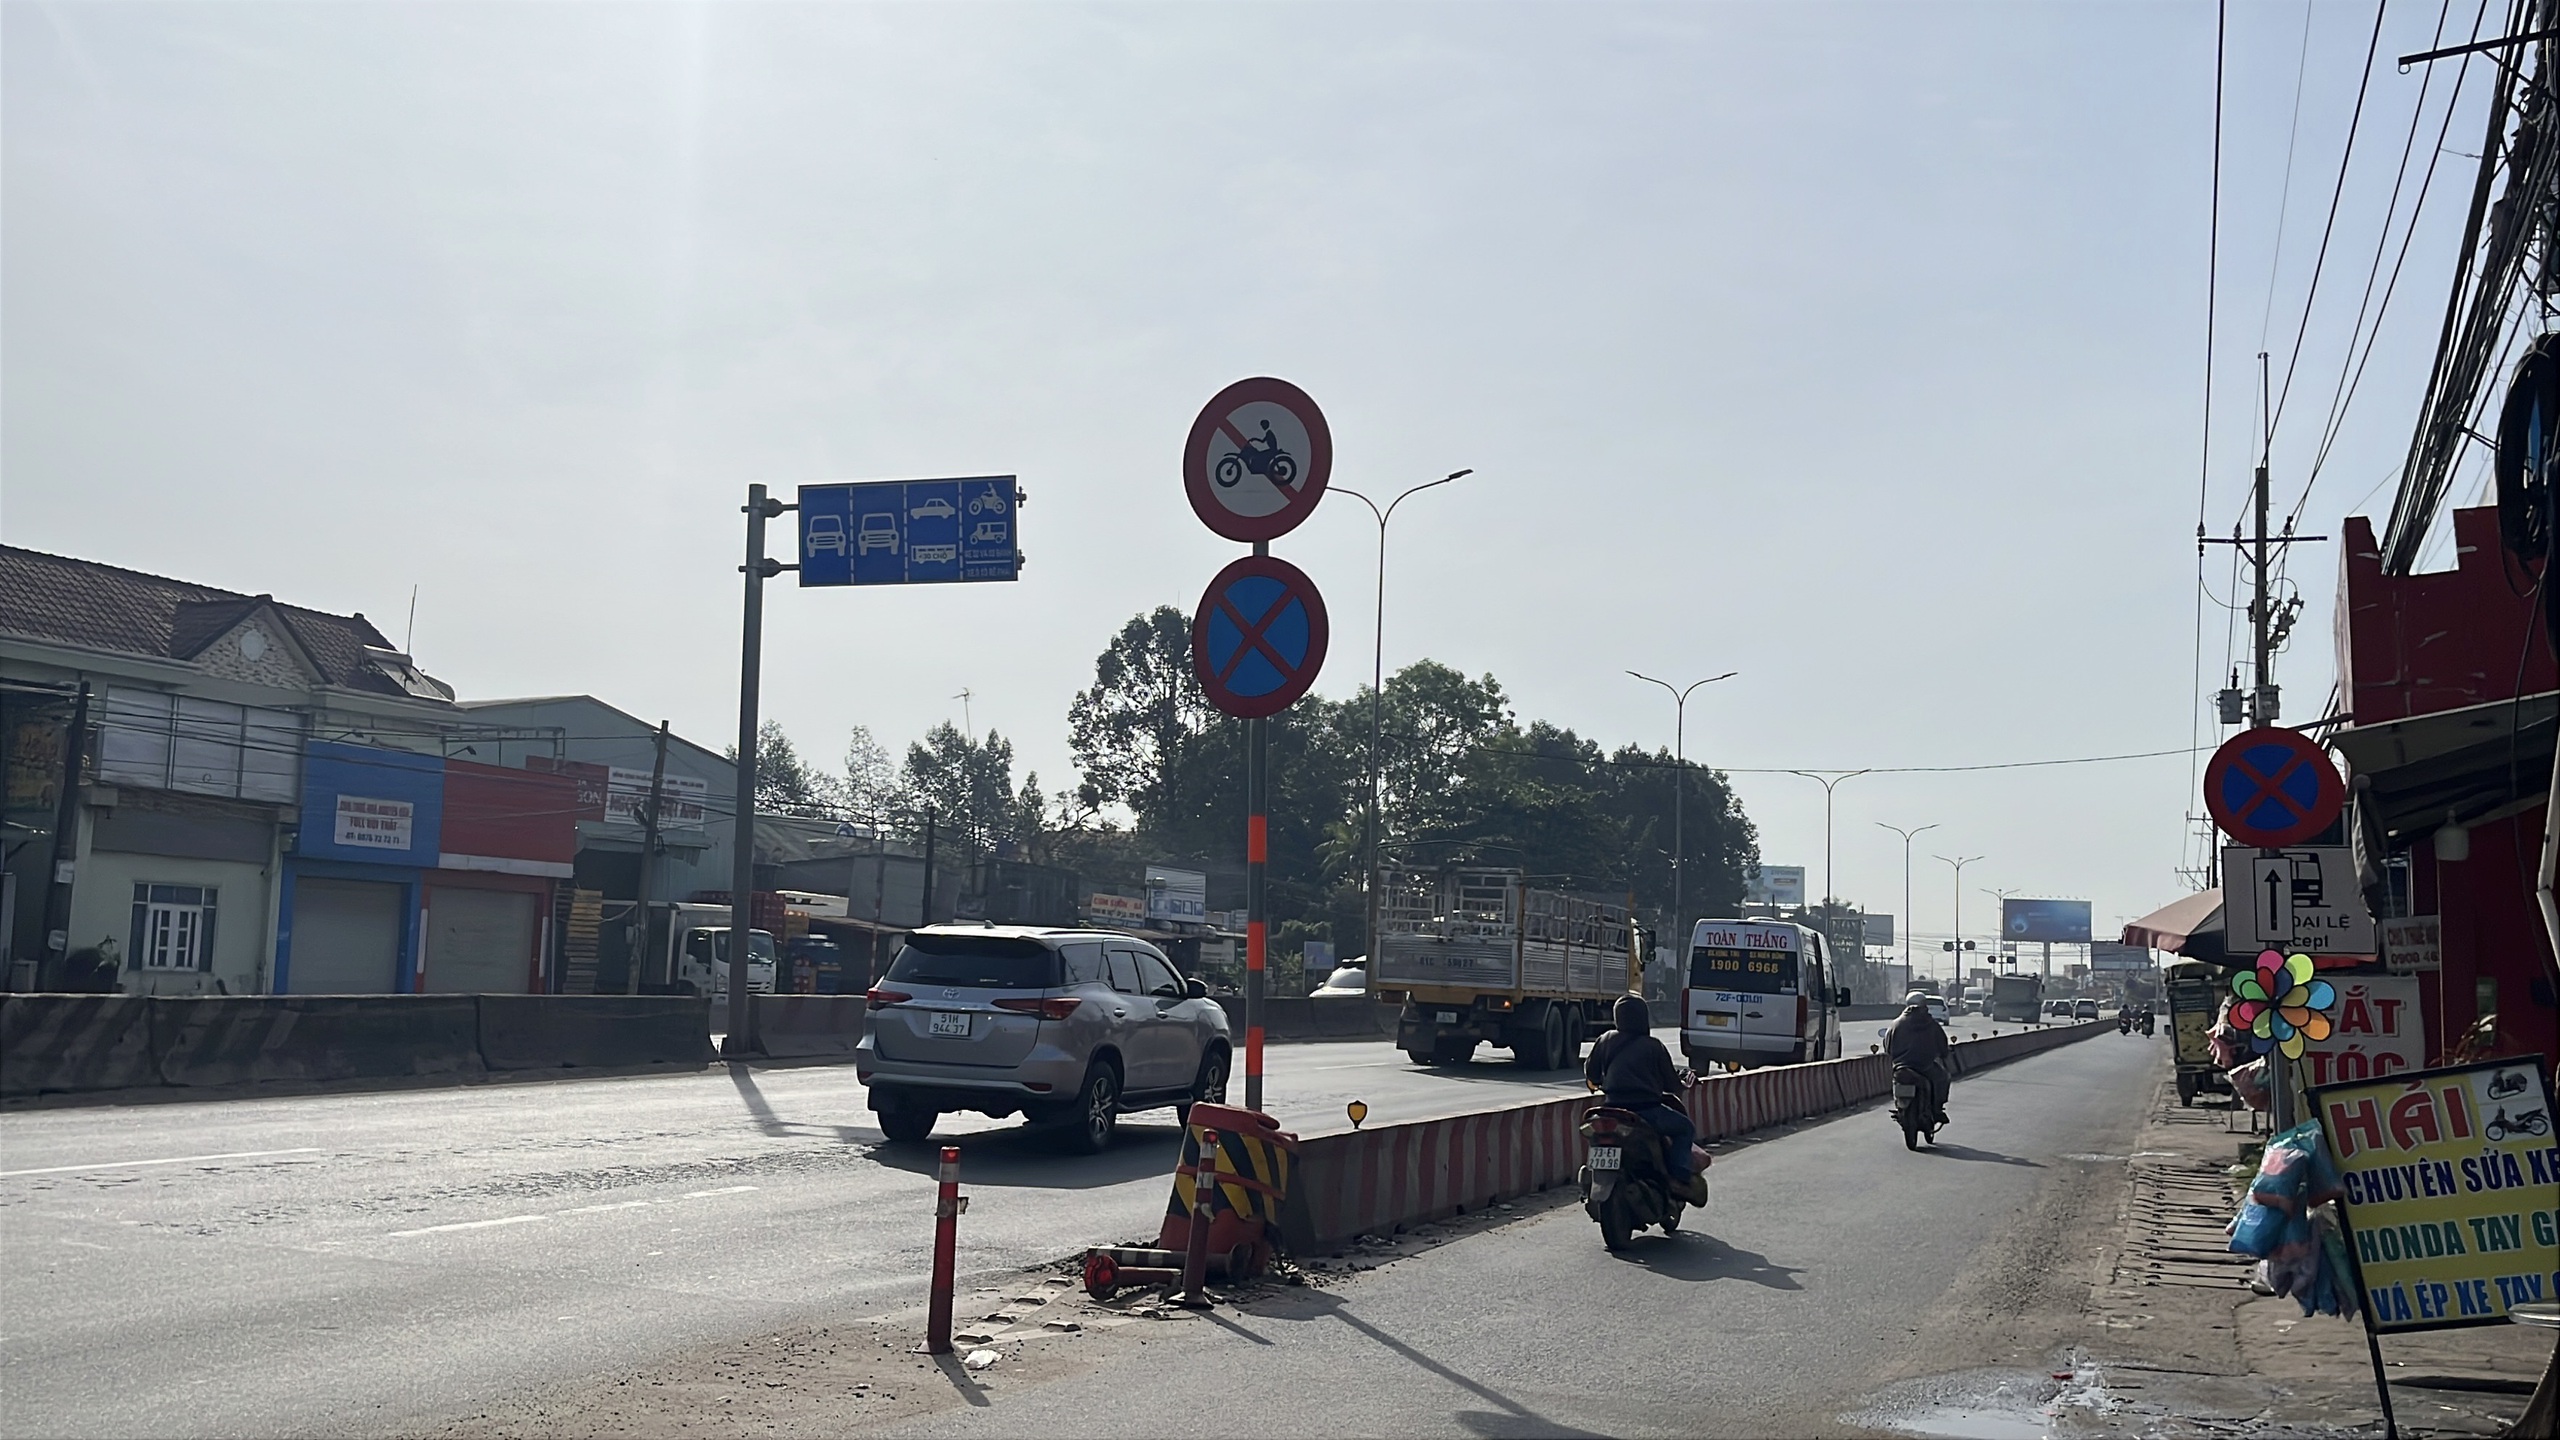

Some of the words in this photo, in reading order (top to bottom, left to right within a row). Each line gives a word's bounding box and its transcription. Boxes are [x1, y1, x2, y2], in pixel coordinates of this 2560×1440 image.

[1706, 929, 1737, 946] TOÀN
[1710, 959, 1740, 971] 1900
[1747, 961, 1779, 974] 6968
[941, 1013, 959, 1024] 51H
[2330, 984, 2402, 1034] ẮT
[2306, 1044, 2405, 1085] TÓC
[2329, 1079, 2471, 1158] HÁI
[2343, 1157, 2457, 1205] CHUYÊN
[2461, 1147, 2525, 1193] SỬA
[2356, 1220, 2466, 1263] HONDA
[2468, 1213, 2521, 1252] TAY
[2531, 1208, 2560, 1246] G
[2371, 1280, 2413, 1323] VÁ
[2454, 1279, 2493, 1316] XE
[2494, 1273, 2542, 1310] TAY
